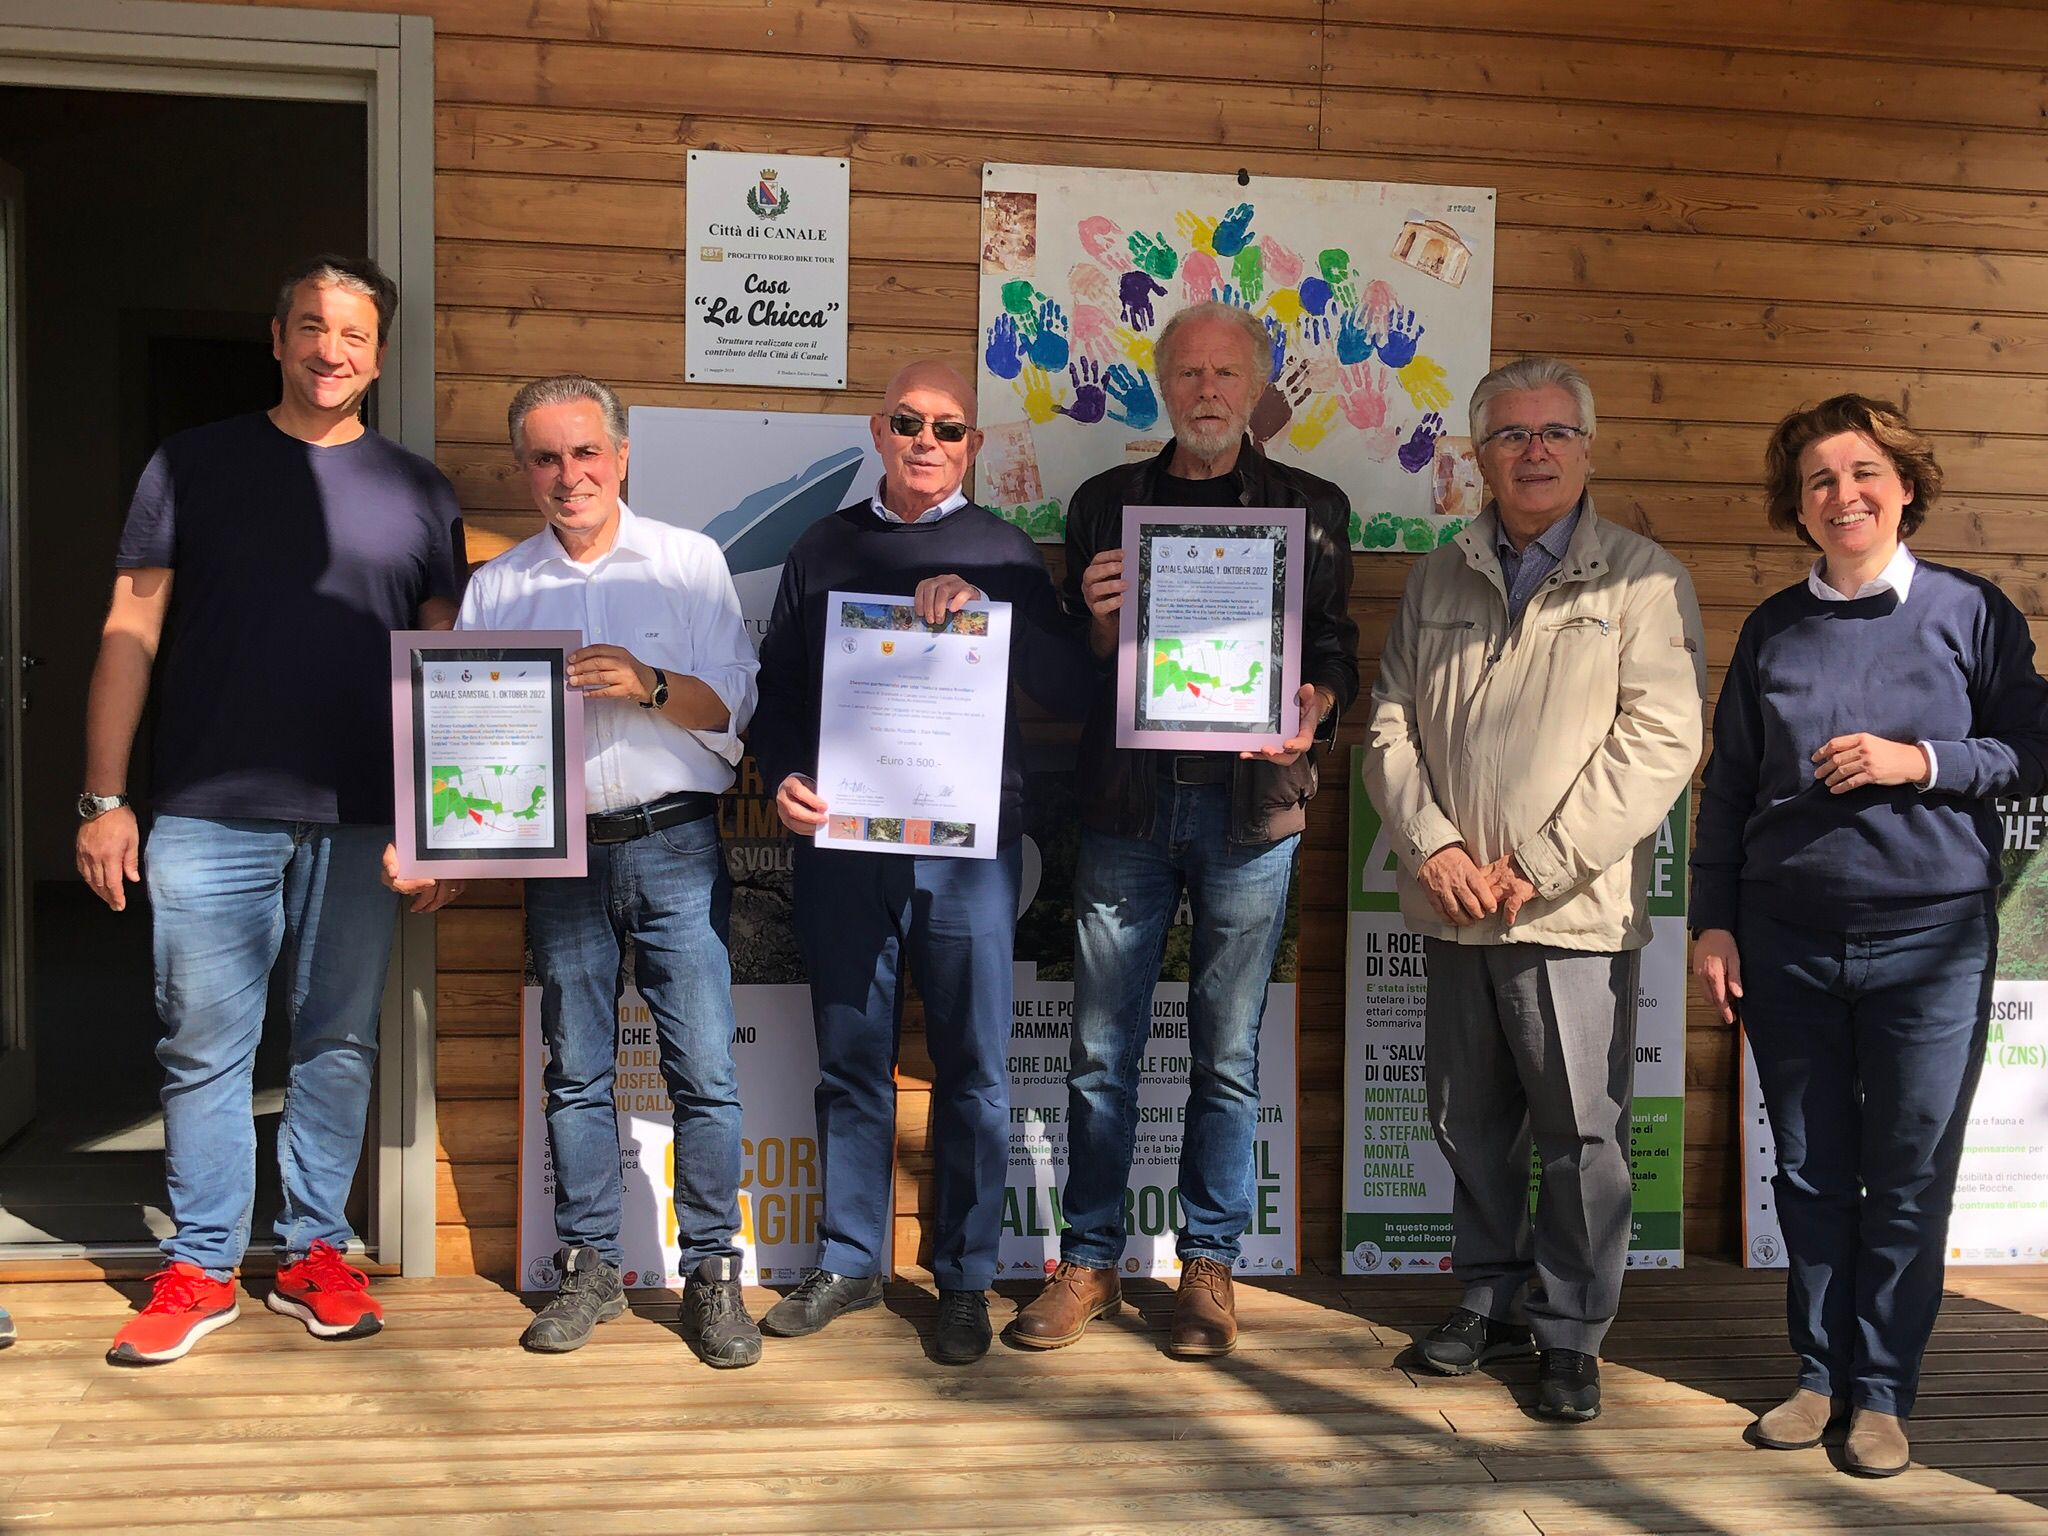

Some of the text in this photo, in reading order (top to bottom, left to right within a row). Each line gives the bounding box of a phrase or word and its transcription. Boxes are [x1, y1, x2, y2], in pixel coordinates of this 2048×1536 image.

[709, 223, 828, 241] Città di CANALE
[727, 251, 835, 264] PROGETTO ROERO BIKE TOUR
[744, 273, 791, 295] Casa
[716, 336, 817, 349] Struttura realizzata con il
[704, 349, 829, 361] contributo della Città di Canale
[1252, 566, 1268, 575] 2022
[499, 689, 528, 699] OKTOBER
[529, 689, 546, 699] 2022
[1366, 932, 1382, 953] IL
[1366, 956, 1384, 977] DI
[1378, 983, 1405, 993] stata
[1366, 995, 1405, 1004] tutelare
[1037, 1000, 1054, 1017] LE
[1366, 1007, 1393, 1016] ettari
[1366, 1019, 1422, 1028] Sommariva
[621, 1028, 652, 1045] CHE
[1364, 1044, 1378, 1060] IL
[1382, 1044, 1426, 1061] “SALV
[1998, 1044, 2047, 1069] (ZNS)
[1365, 1065, 1379, 1081] DI
[1364, 1106, 1419, 1122] MONTEU
[1652, 1113, 1668, 1122] del
[1991, 1116, 2017, 1126] fauna
[1364, 1125, 1376, 1141] S.
[1643, 1125, 1653, 1134] di
[1038, 1134, 1056, 1145] per
[1058, 1132, 1064, 1143] il
[1159, 1134, 1178, 1142] una
[1364, 1142, 1410, 1159] MONTÀ
[1654, 1148, 1669, 1157] del
[2028, 1145, 2043, 1155] per
[1040, 1156, 1065, 1166] nelle
[1363, 1163, 1415, 1178] CANALE
[1995, 1172, 2004, 1182] di
[1363, 1182, 1427, 1197] CISTERNA
[1979, 1184, 2016, 1193] Rocche.
[1959, 1202, 2005, 1210] contrasto
[1384, 1222, 1394, 1231] In
[1395, 1223, 1429, 1234] questo
[1384, 1234, 1451, 1243] aree del Roero
